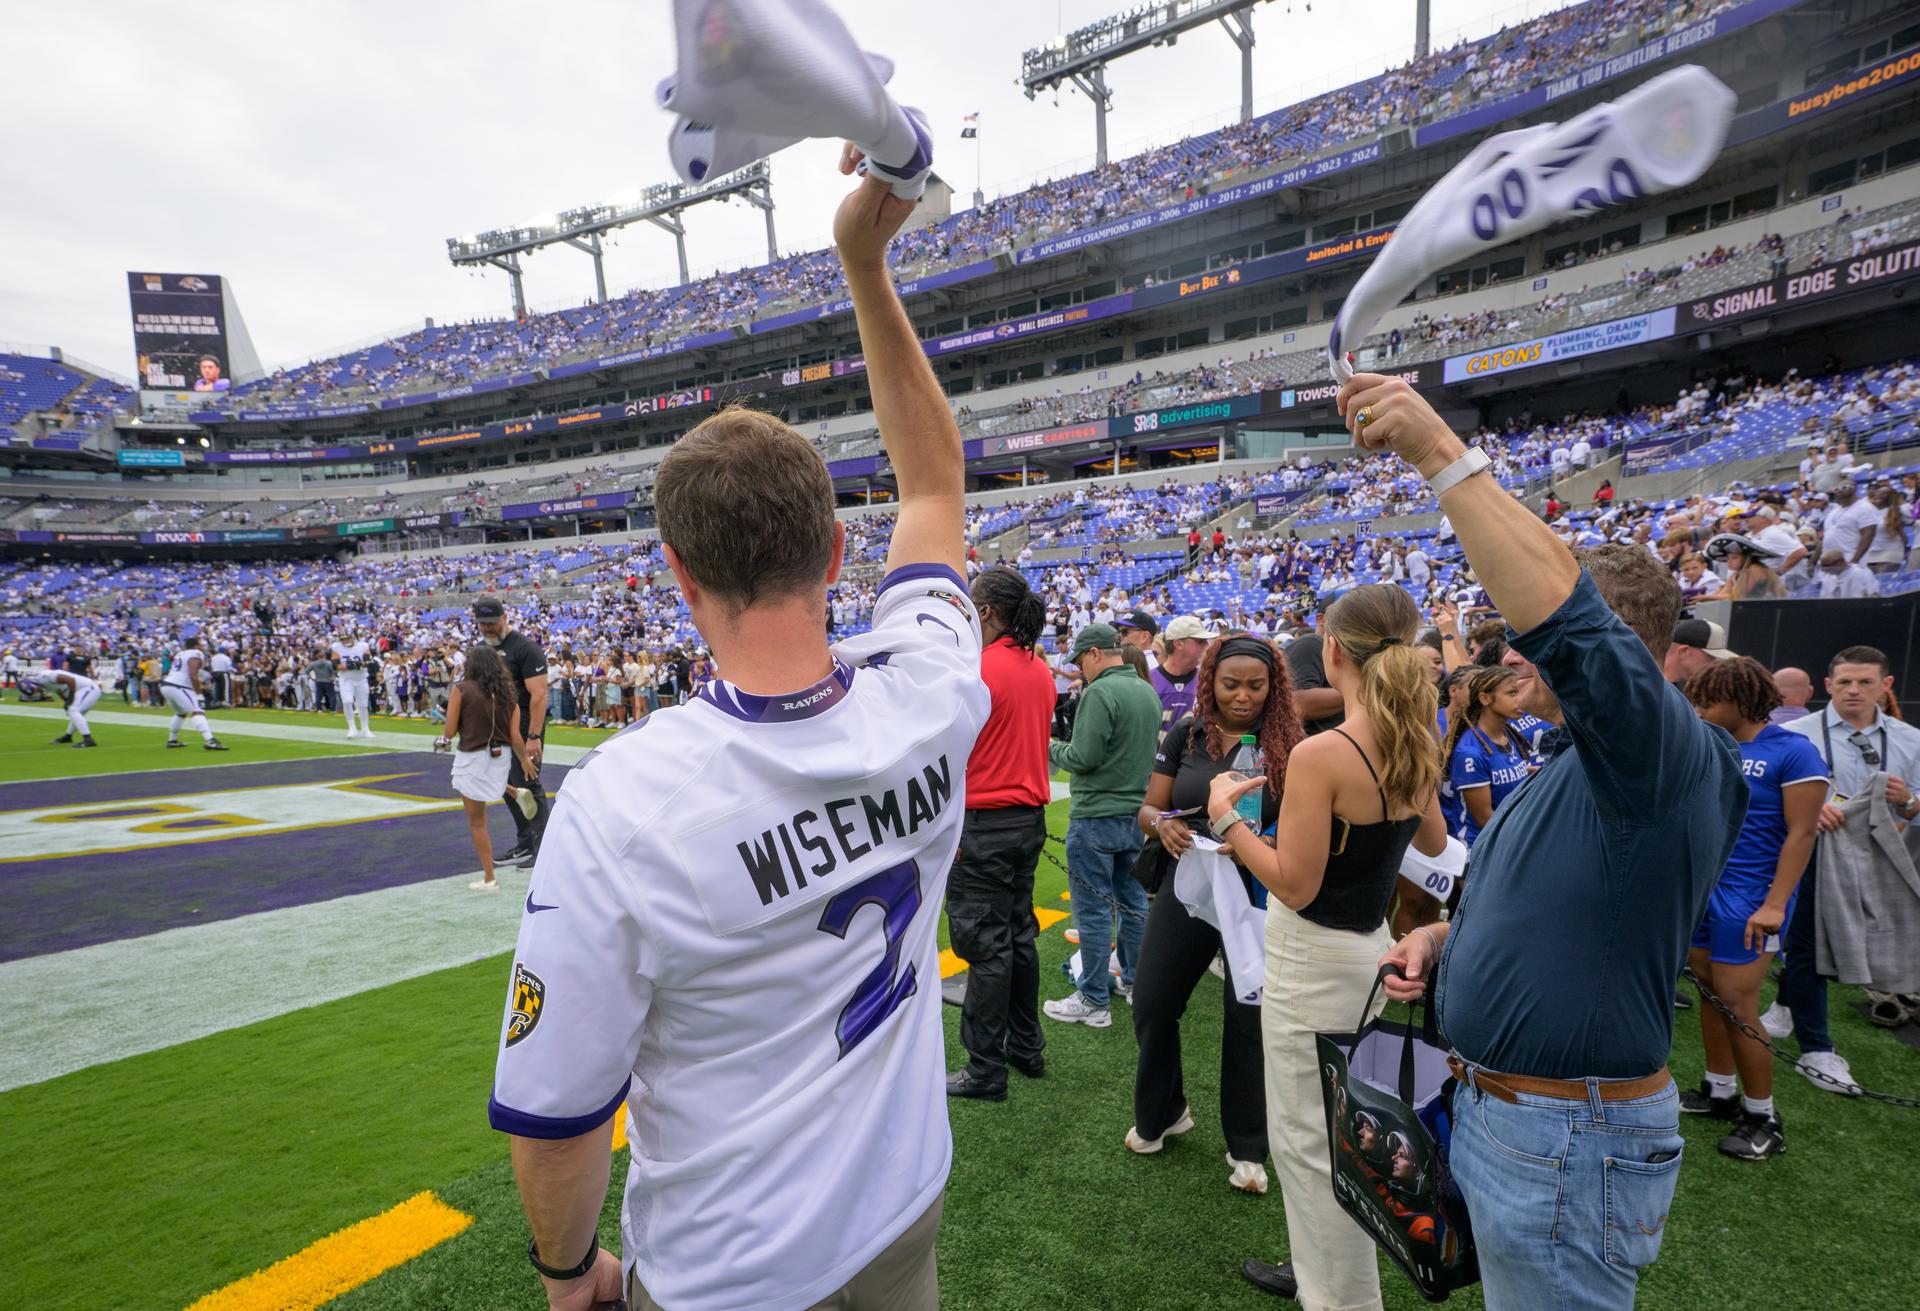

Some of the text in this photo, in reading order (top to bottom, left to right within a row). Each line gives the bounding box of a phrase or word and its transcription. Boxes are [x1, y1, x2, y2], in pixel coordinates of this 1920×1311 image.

[1545, 19, 1717, 102] THANK YOU FRONTLINE HEROES!
[1040, 145, 1378, 255] AFC NORTH CHAMPIONS 2003 2006 2011 2012 2018 2019 2023 2024
[1306, 239, 1353, 262] Janitorial
[1355, 239, 1364, 250] &
[1713, 284, 1776, 319] SIGNAL
[1787, 268, 1838, 300] EDGE
[1037, 314, 1064, 328] BUSINESS
[1547, 318, 1648, 348] PLUMBING, DRAINS
[1552, 330, 1642, 357] & WATER CLEANUP
[1466, 342, 1543, 375] CATONS
[1160, 402, 1231, 424] advertising
[1007, 427, 1097, 450] WISE COATINGS
[1357, 521, 1372, 536] 132
[781, 685, 833, 710] RAVENS
[1464, 757, 1475, 773] 2
[736, 754, 951, 907] WISEMAN
[1424, 872, 1450, 893] 00
[816, 858, 922, 1062] 2
